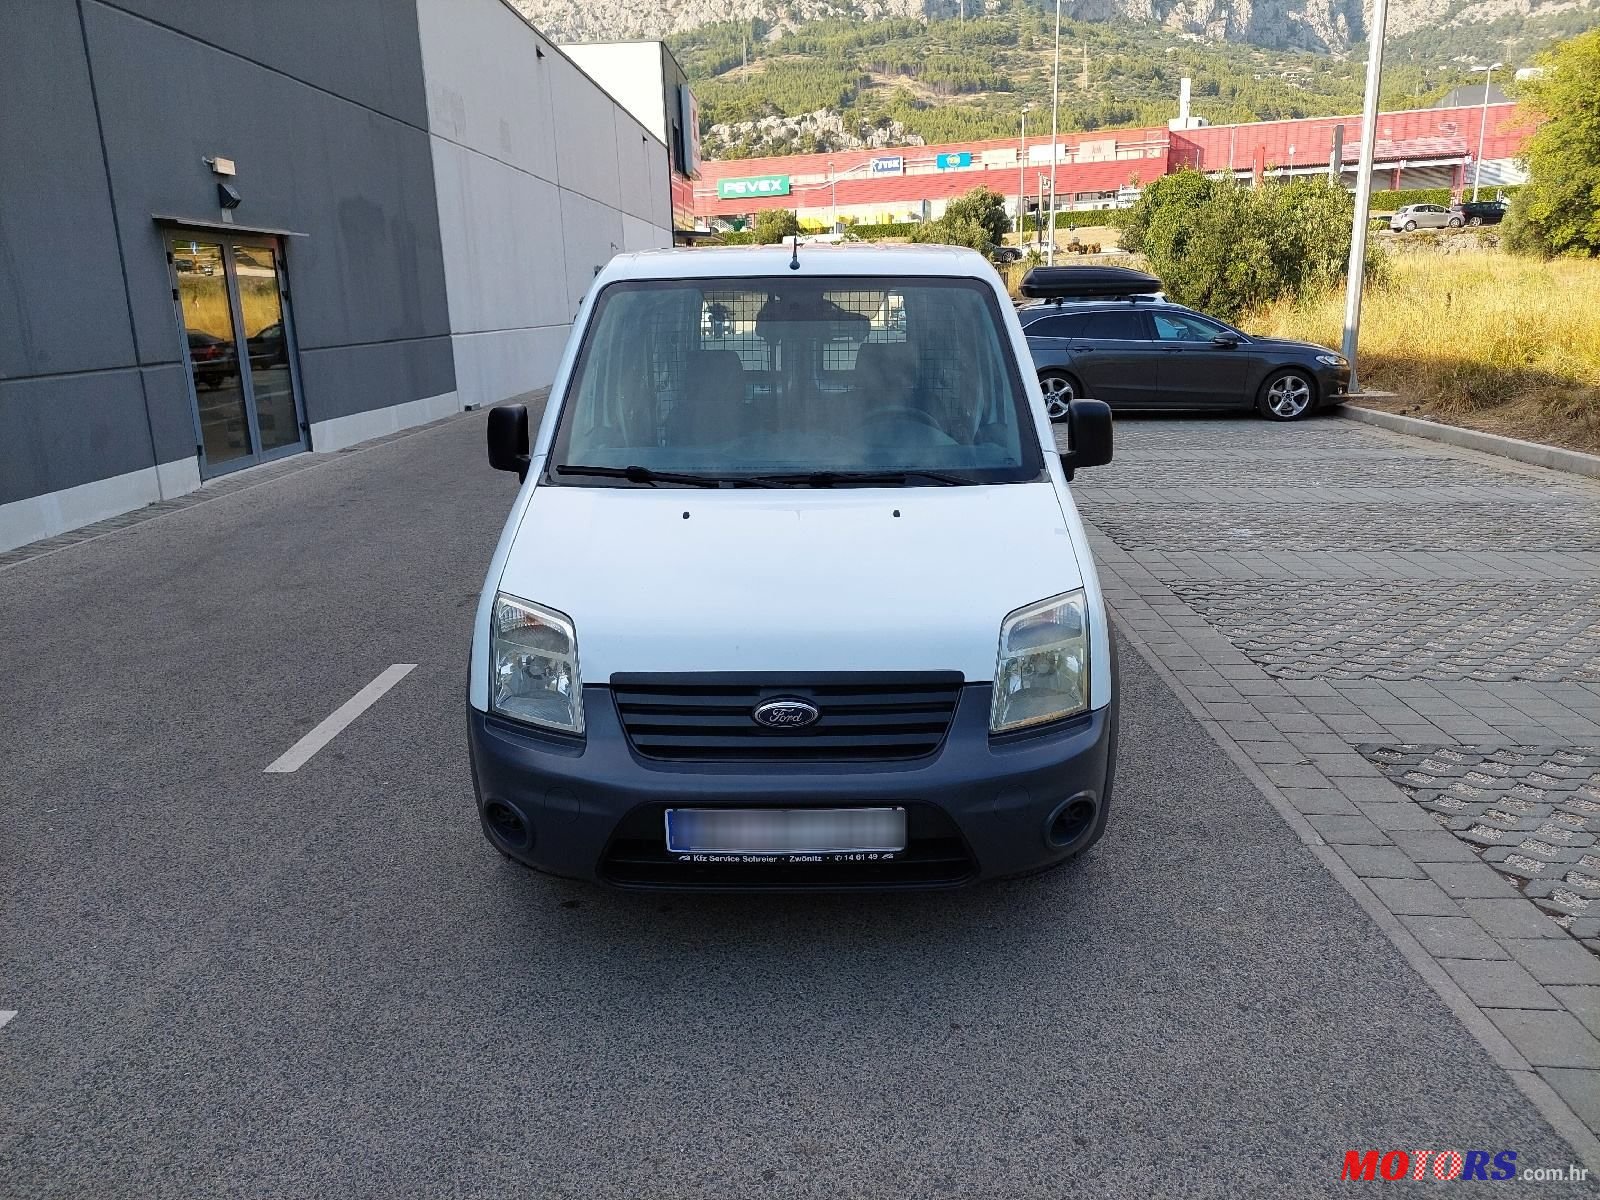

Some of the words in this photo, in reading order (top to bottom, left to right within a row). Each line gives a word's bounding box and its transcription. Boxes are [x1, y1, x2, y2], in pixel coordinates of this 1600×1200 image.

[724, 179, 783, 195] PEVEX
[769, 708, 803, 723] Ford
[693, 854, 708, 862] Kfz
[709, 855, 740, 863] Service
